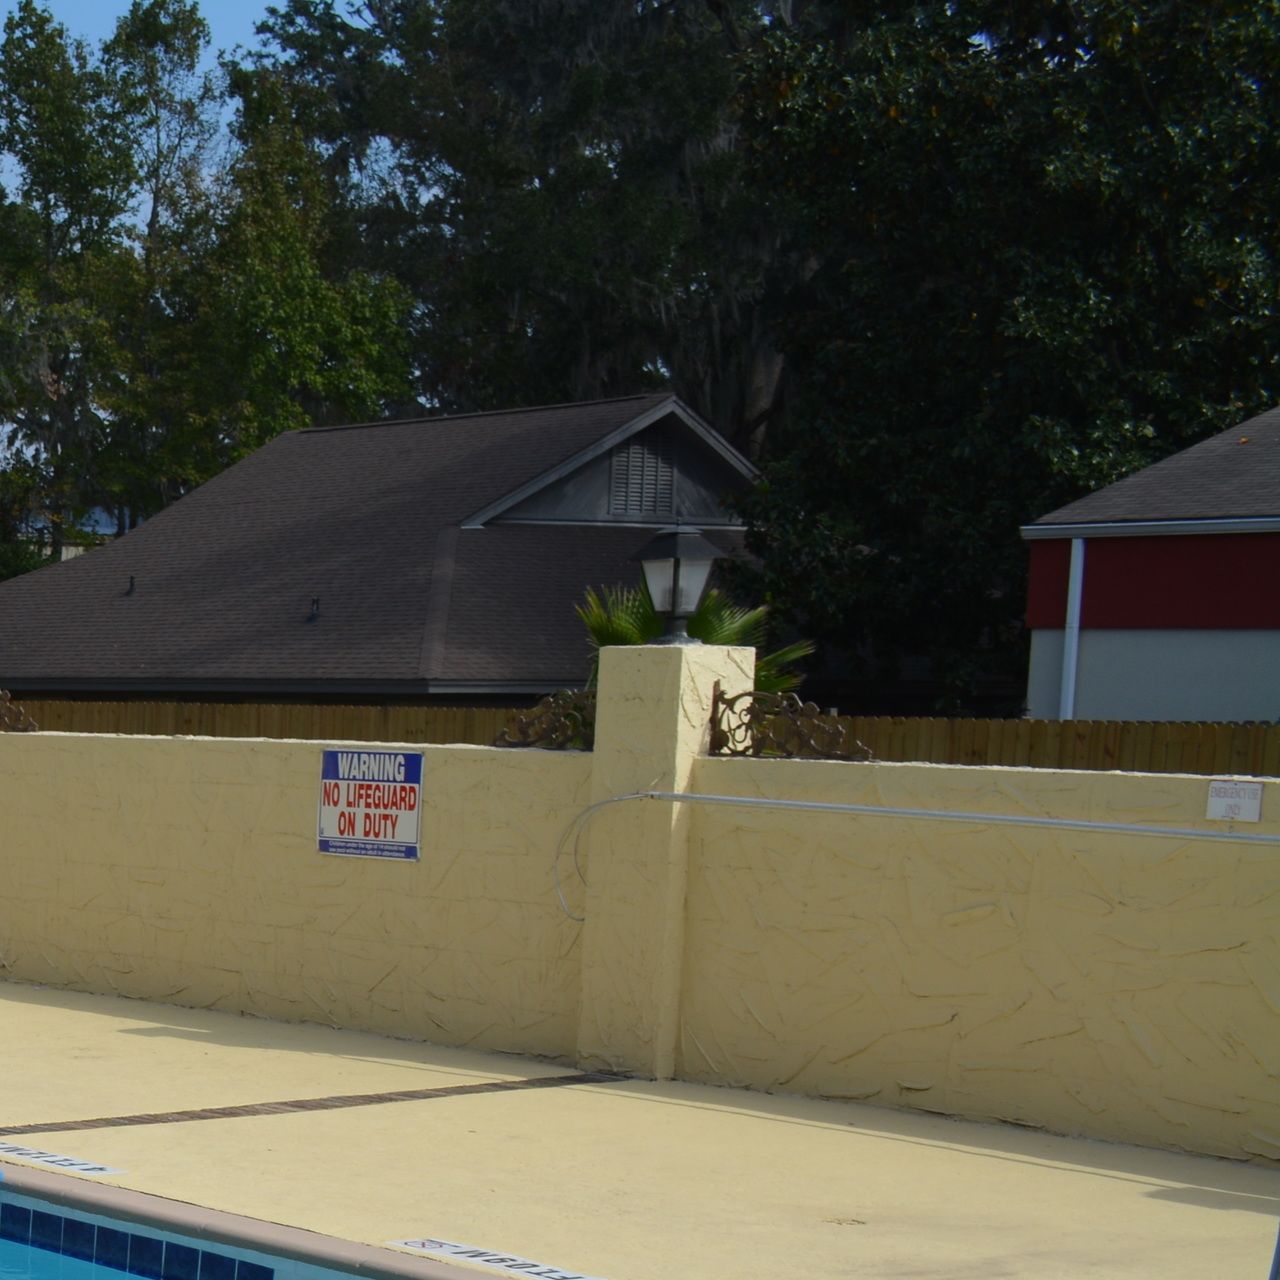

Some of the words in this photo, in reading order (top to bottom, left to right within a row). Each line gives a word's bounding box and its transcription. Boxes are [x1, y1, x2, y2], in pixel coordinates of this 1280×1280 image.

[338, 753, 405, 781] WARNING
[323, 782, 340, 807] NO
[346, 783, 417, 811] LIFEGUARD
[338, 811, 356, 837] ON
[363, 812, 399, 839] DUTY
